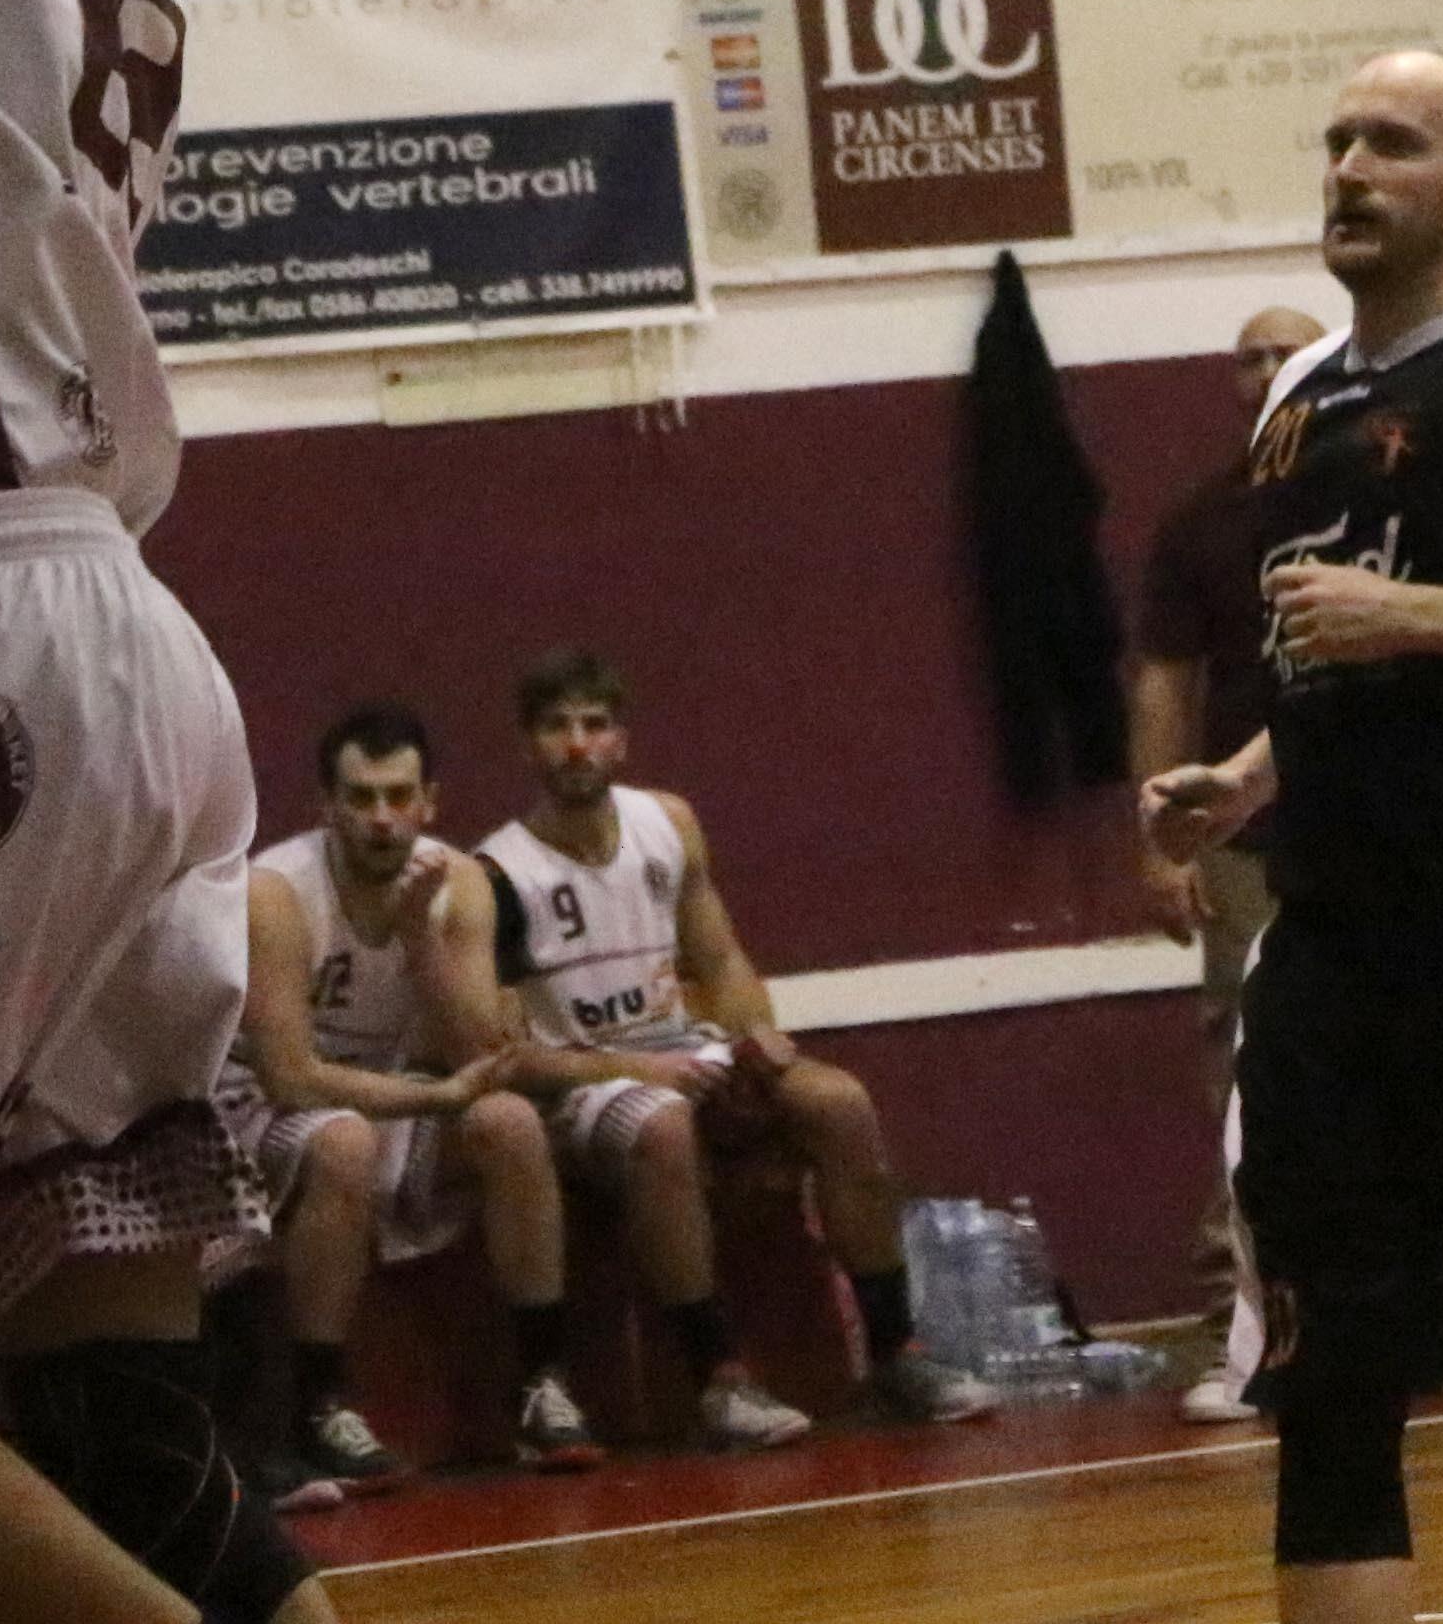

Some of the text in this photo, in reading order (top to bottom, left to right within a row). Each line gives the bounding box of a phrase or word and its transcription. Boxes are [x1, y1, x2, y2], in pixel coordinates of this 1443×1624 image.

[830, 97, 1040, 150] PANEM ET
[328, 158, 599, 214] vertebrali
[831, 134, 1046, 185] CIRCENSES
[550, 882, 586, 941] 9
